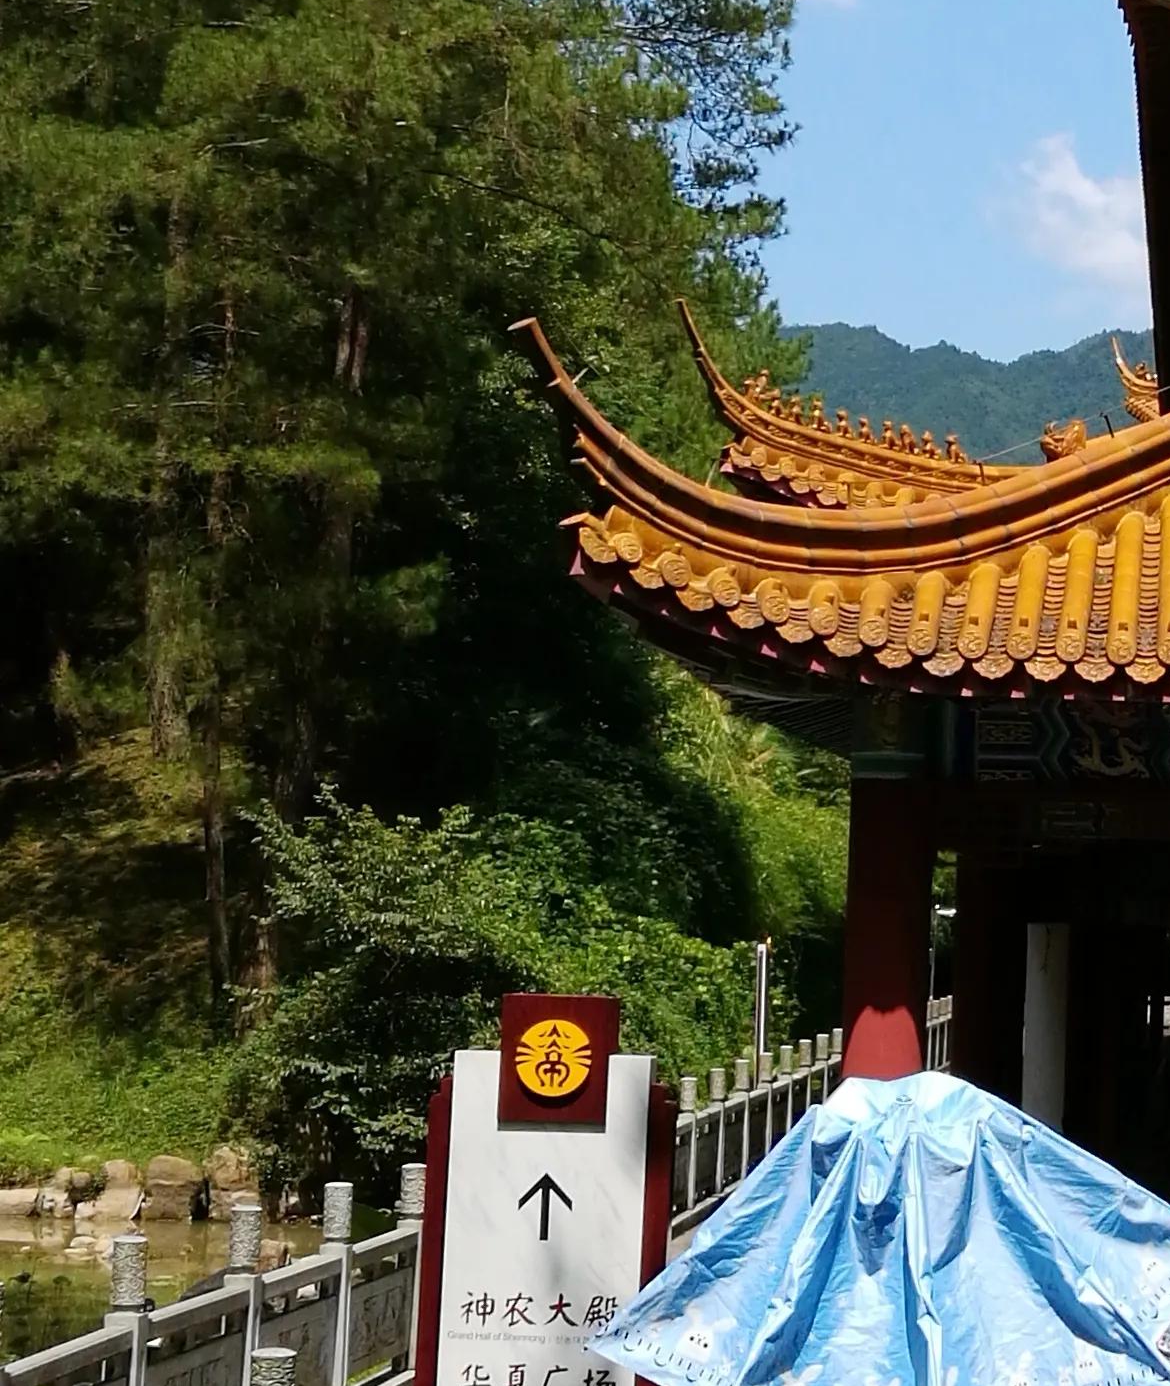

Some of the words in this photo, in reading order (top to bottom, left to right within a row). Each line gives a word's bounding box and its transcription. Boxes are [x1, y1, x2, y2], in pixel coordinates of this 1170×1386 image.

[461, 1291, 619, 1331] 神农大殿
[447, 1330, 473, 1341] Grand
[492, 1332, 502, 1341] of
